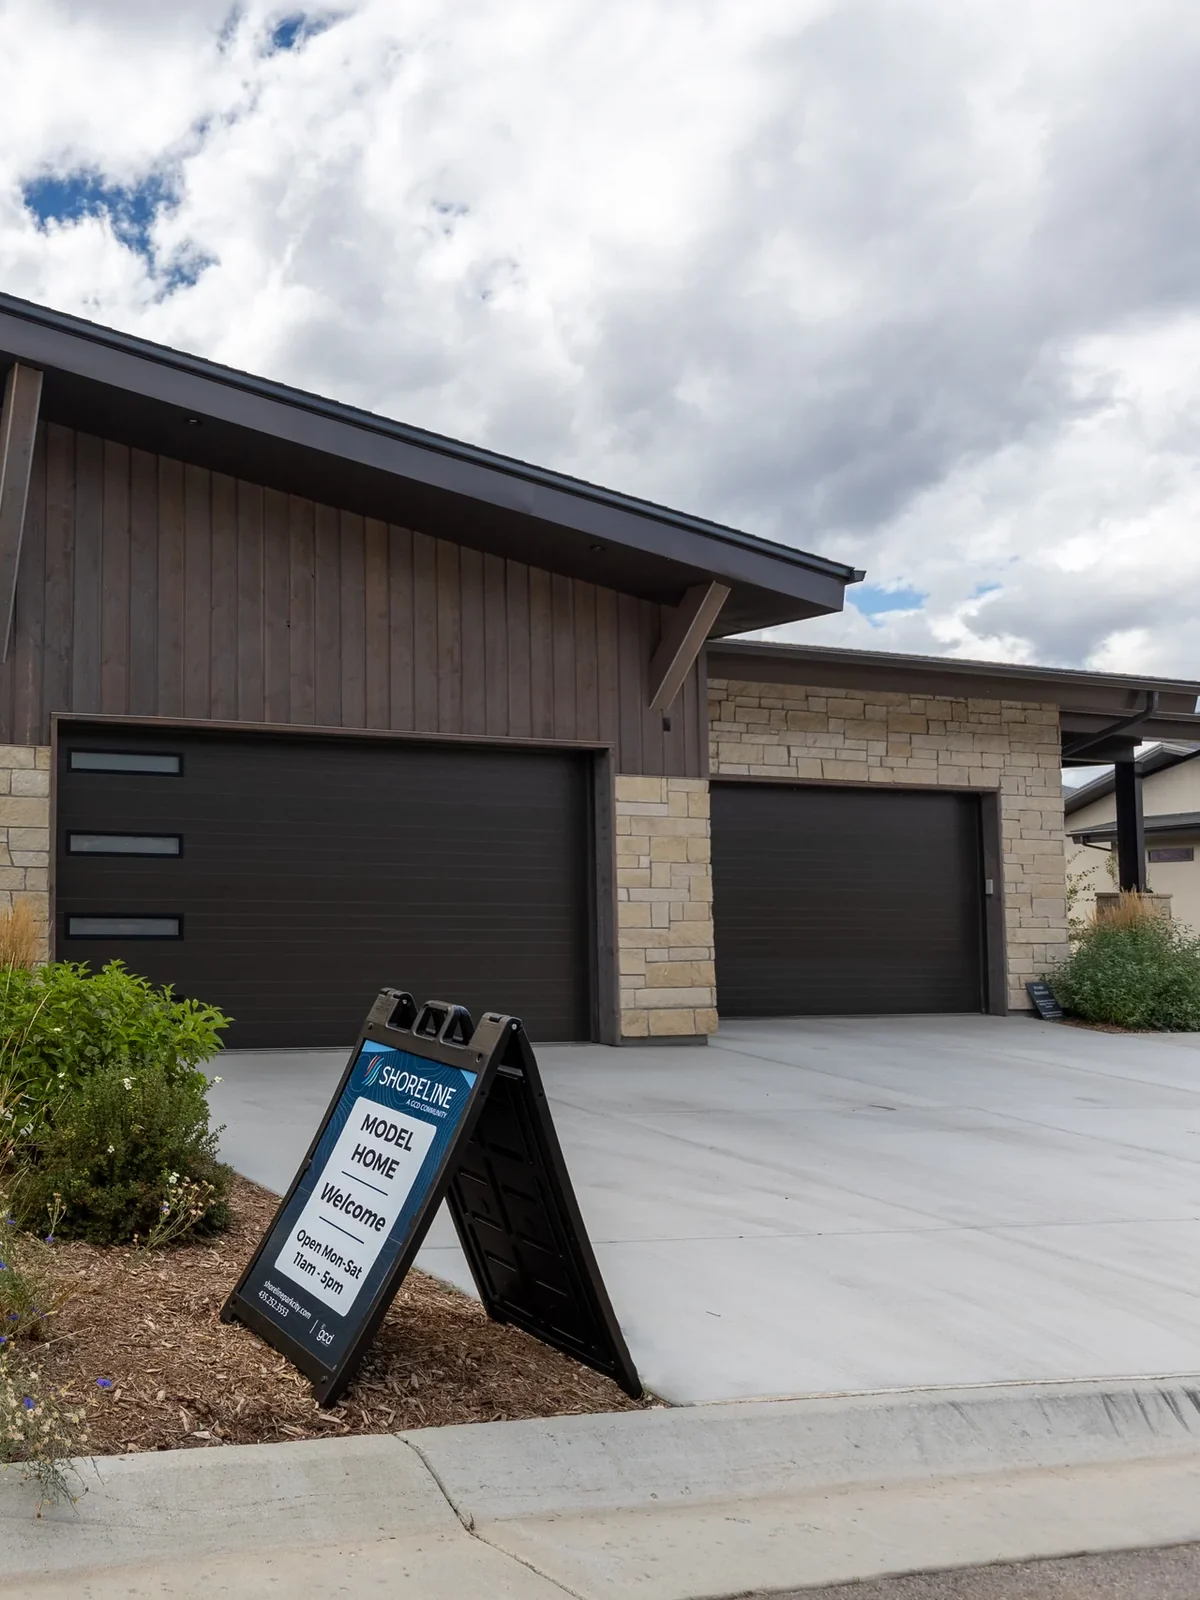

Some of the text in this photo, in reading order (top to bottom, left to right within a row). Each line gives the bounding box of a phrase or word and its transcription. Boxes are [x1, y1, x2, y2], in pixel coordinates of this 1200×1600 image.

[379, 1066, 457, 1109] SHORELINE
[360, 1113, 414, 1152] MODEL
[350, 1143, 400, 1180] HOME
[320, 1182, 386, 1232] Welcome
[293, 1251, 317, 1276] 11am
[320, 1270, 344, 1295] 5pm
[296, 1229, 363, 1280] Open Mon-Sat
[258, 1290, 289, 1317] 435.252.3553
[263, 1280, 312, 1320] shorelineparkcity.com
[316, 1329, 335, 1345] gcd
